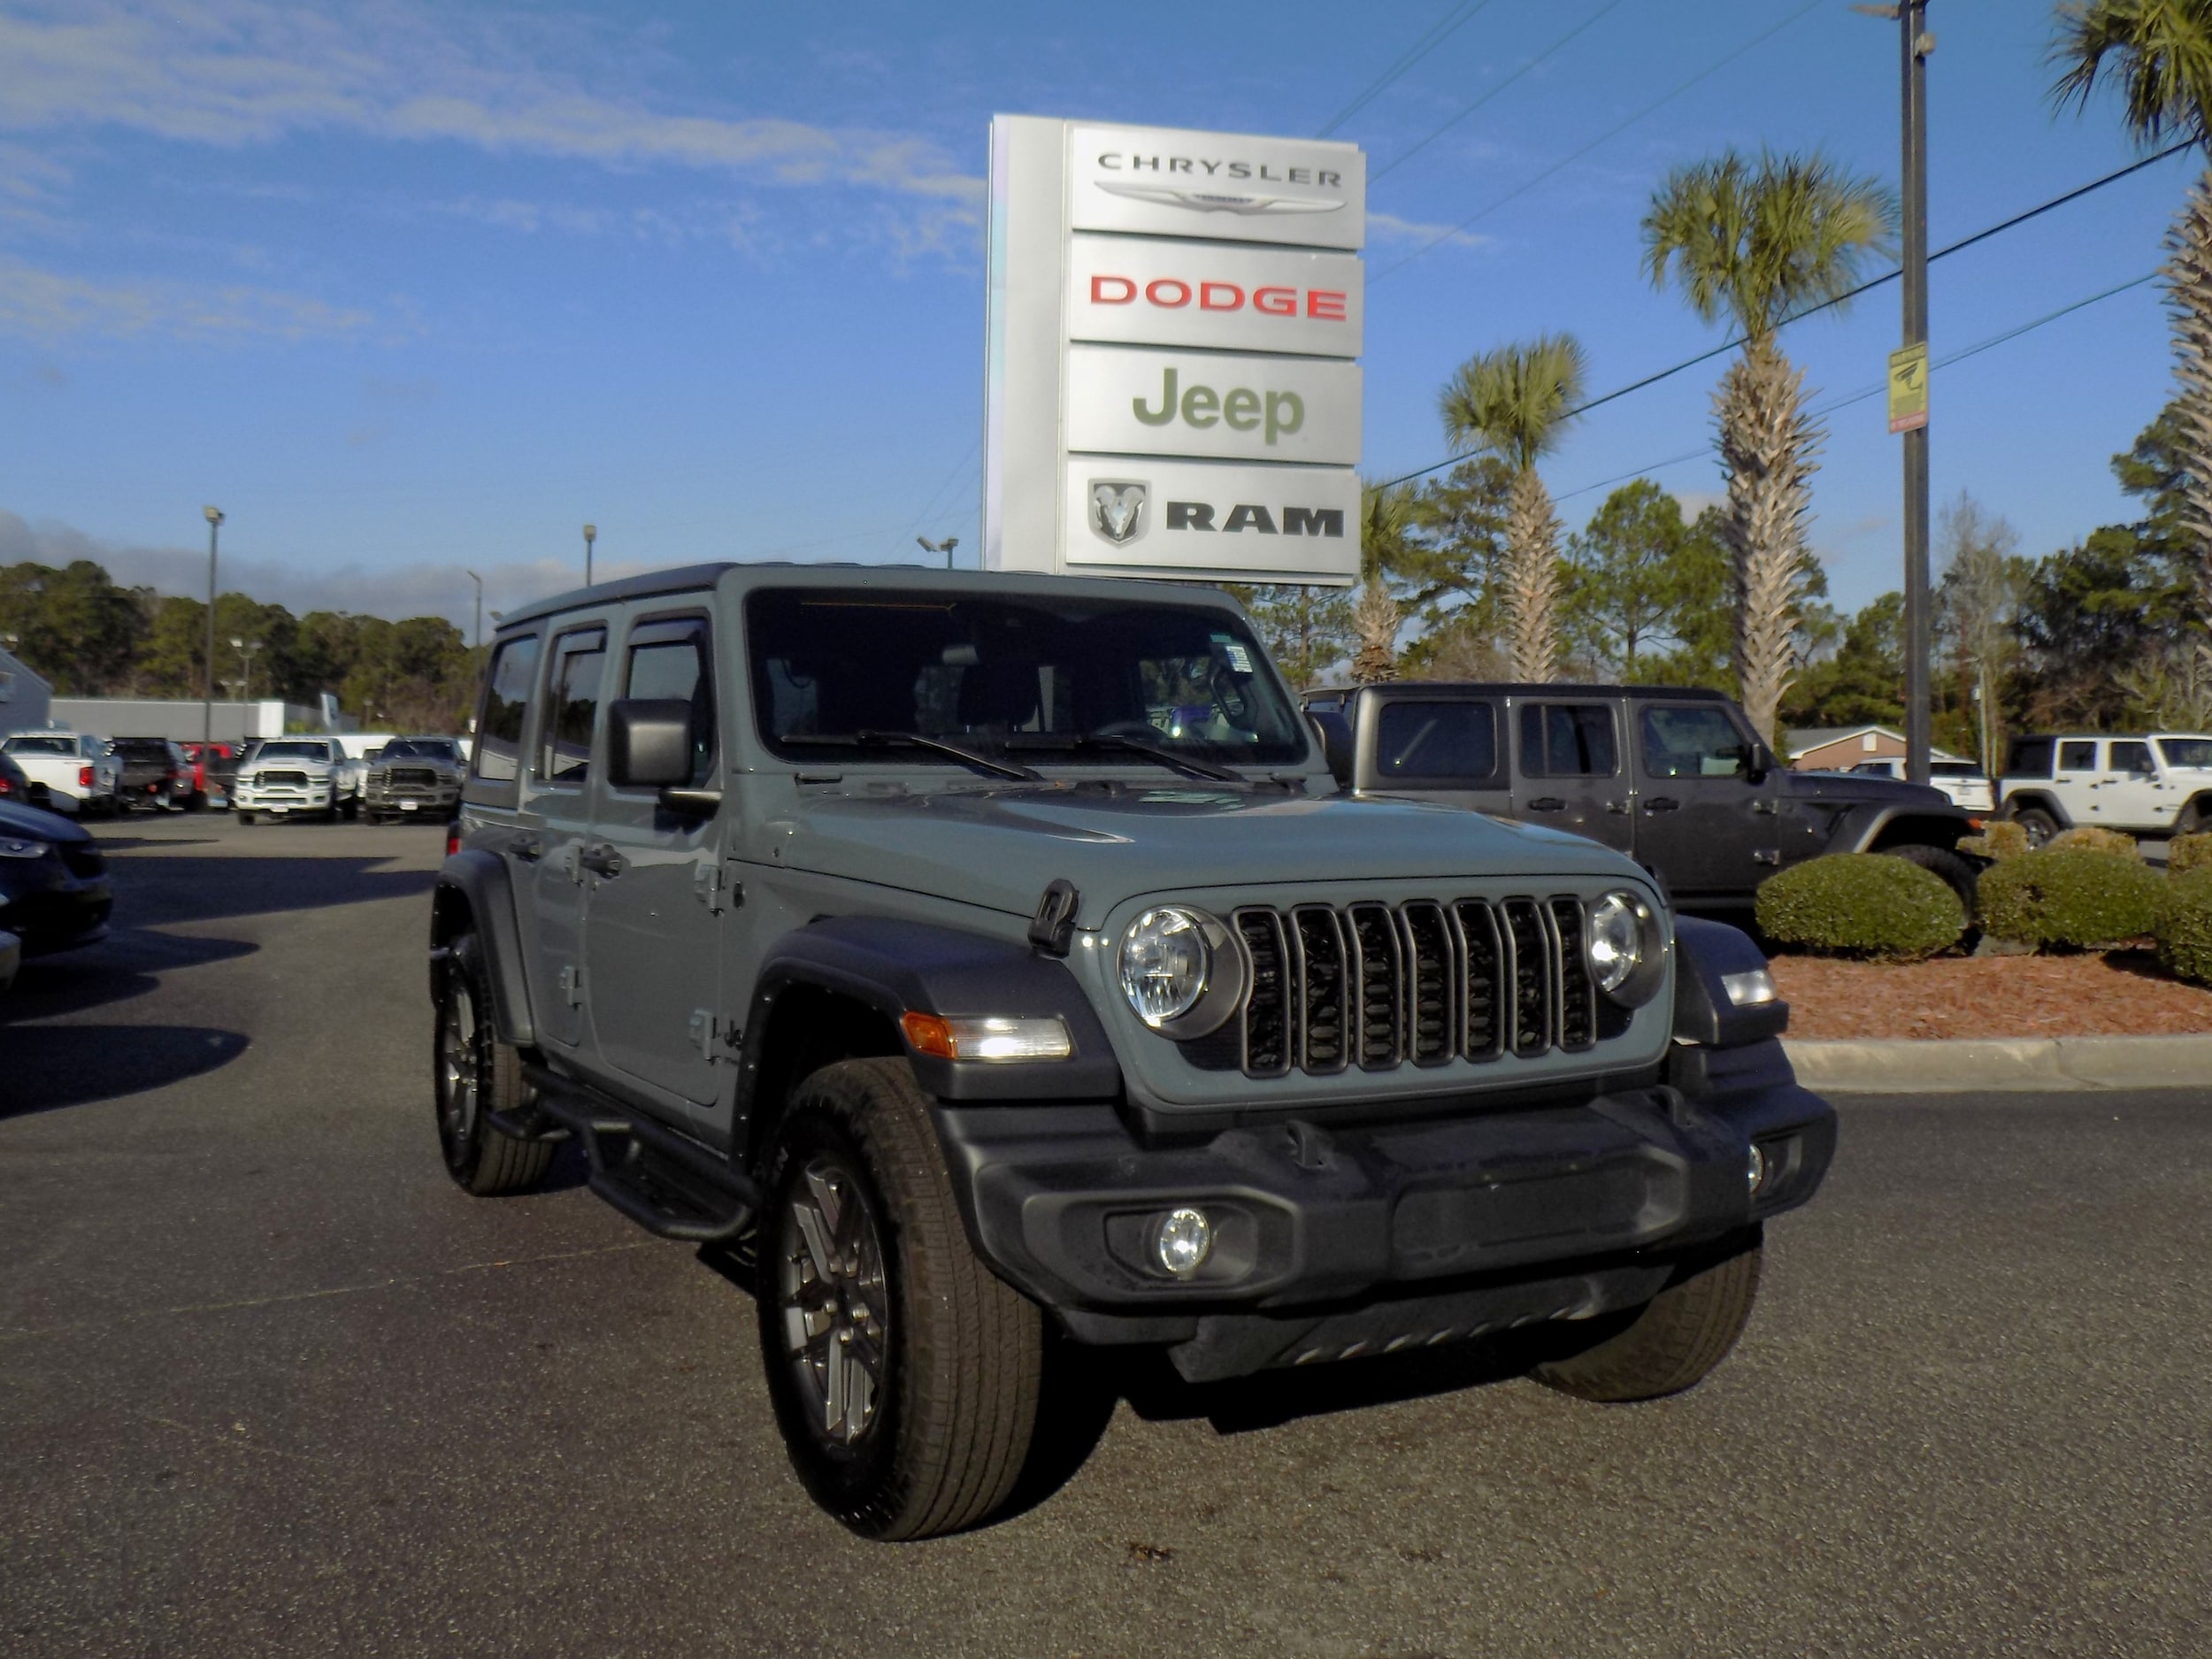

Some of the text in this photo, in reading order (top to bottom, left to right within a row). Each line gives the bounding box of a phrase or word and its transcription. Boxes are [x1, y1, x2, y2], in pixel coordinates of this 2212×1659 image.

[1098, 153, 1341, 188] CHRYSLER
[1091, 276, 1347, 321] DODGE
[1133, 367, 1304, 445] Jeep
[1166, 501, 1344, 538] RAM
